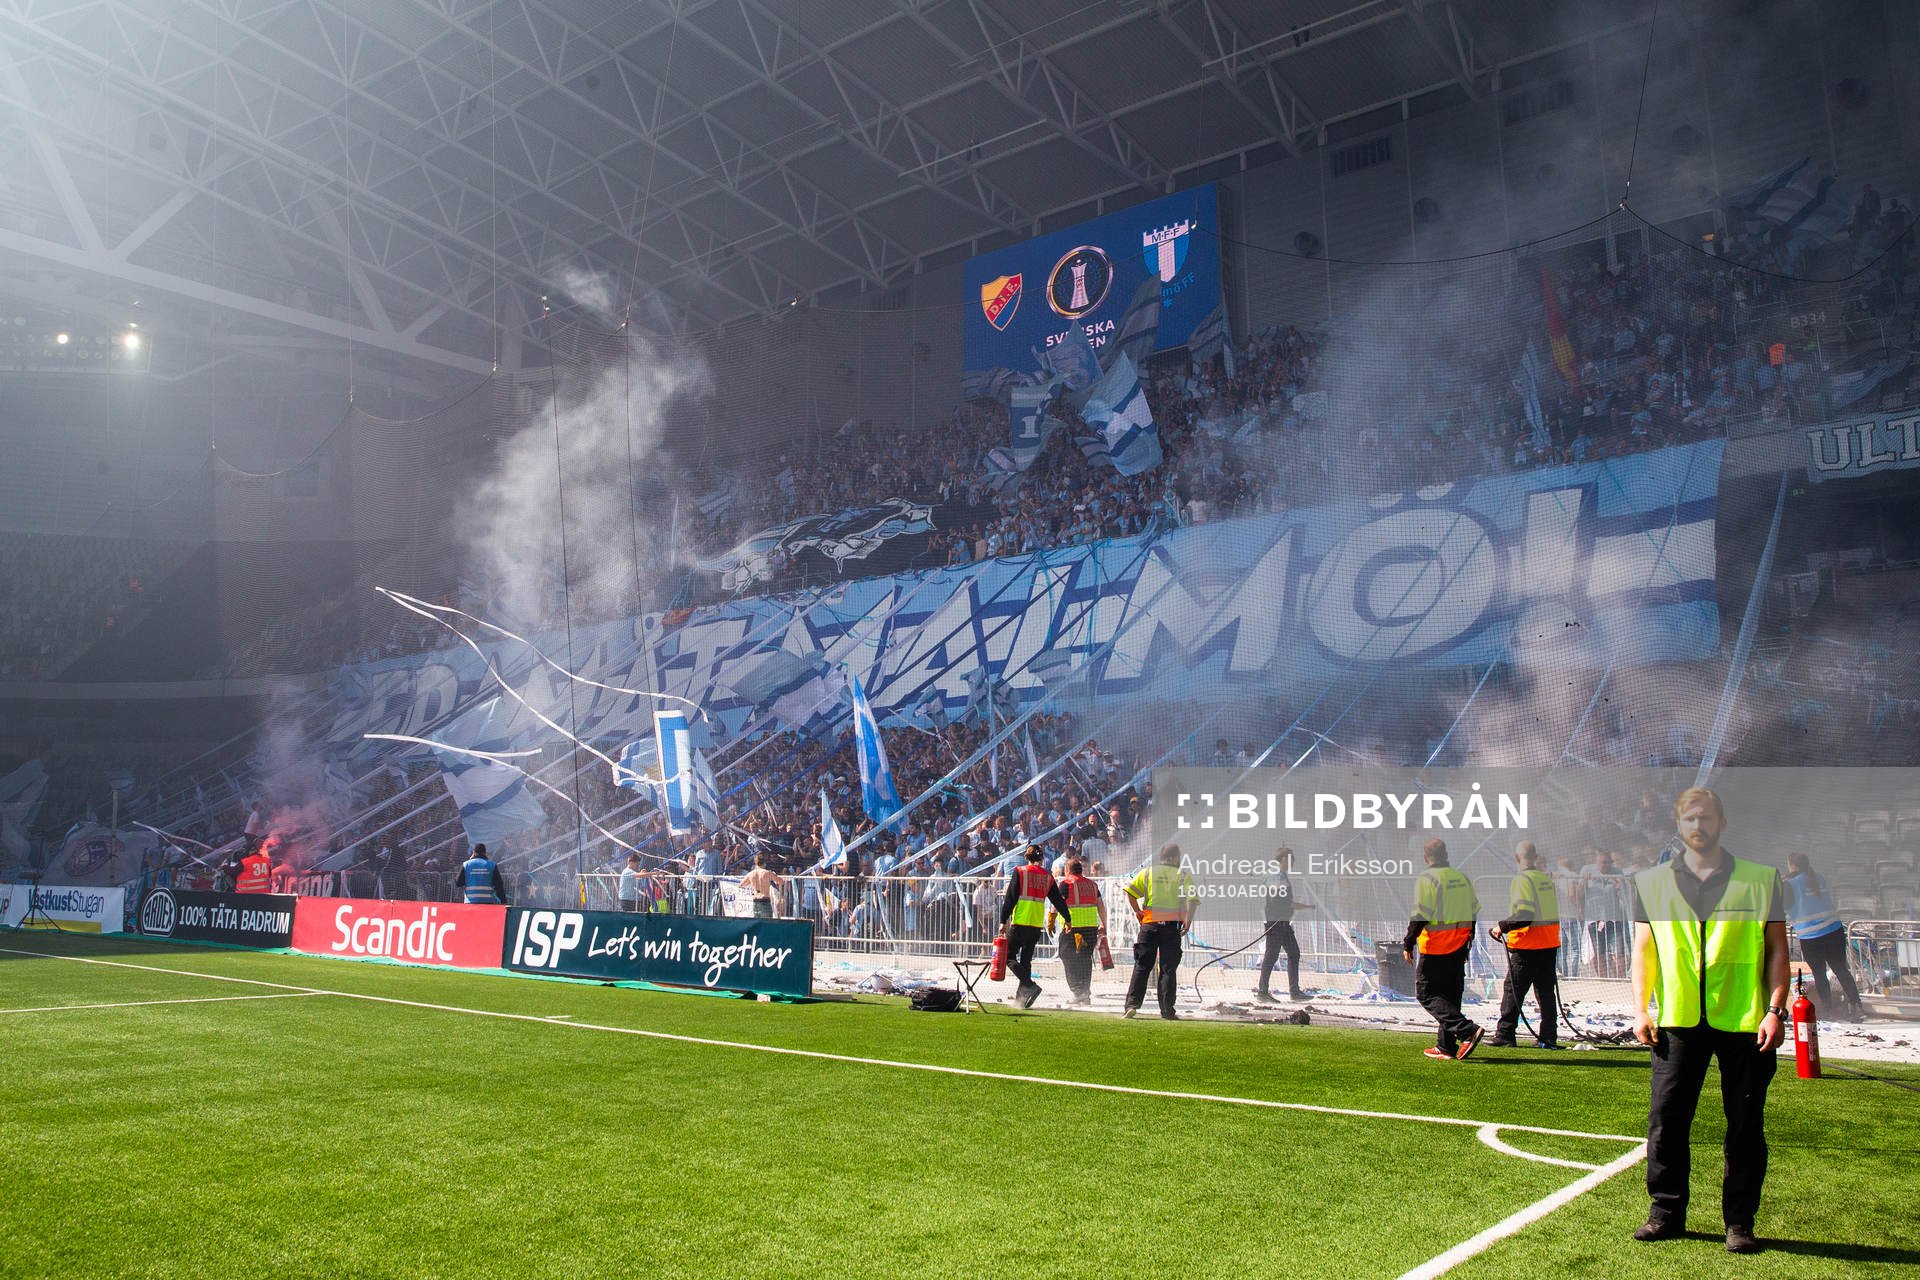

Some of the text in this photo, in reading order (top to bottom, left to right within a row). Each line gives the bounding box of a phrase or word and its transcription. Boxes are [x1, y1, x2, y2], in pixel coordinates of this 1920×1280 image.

[1046, 319, 1116, 347] SVSKA
[252, 863, 268, 876] 34
[179, 903, 290, 934] 100% TÄTA BADRUM
[332, 905, 456, 961] Scandic
[512, 911, 584, 968] ISP
[588, 926, 792, 987] Let's win together
